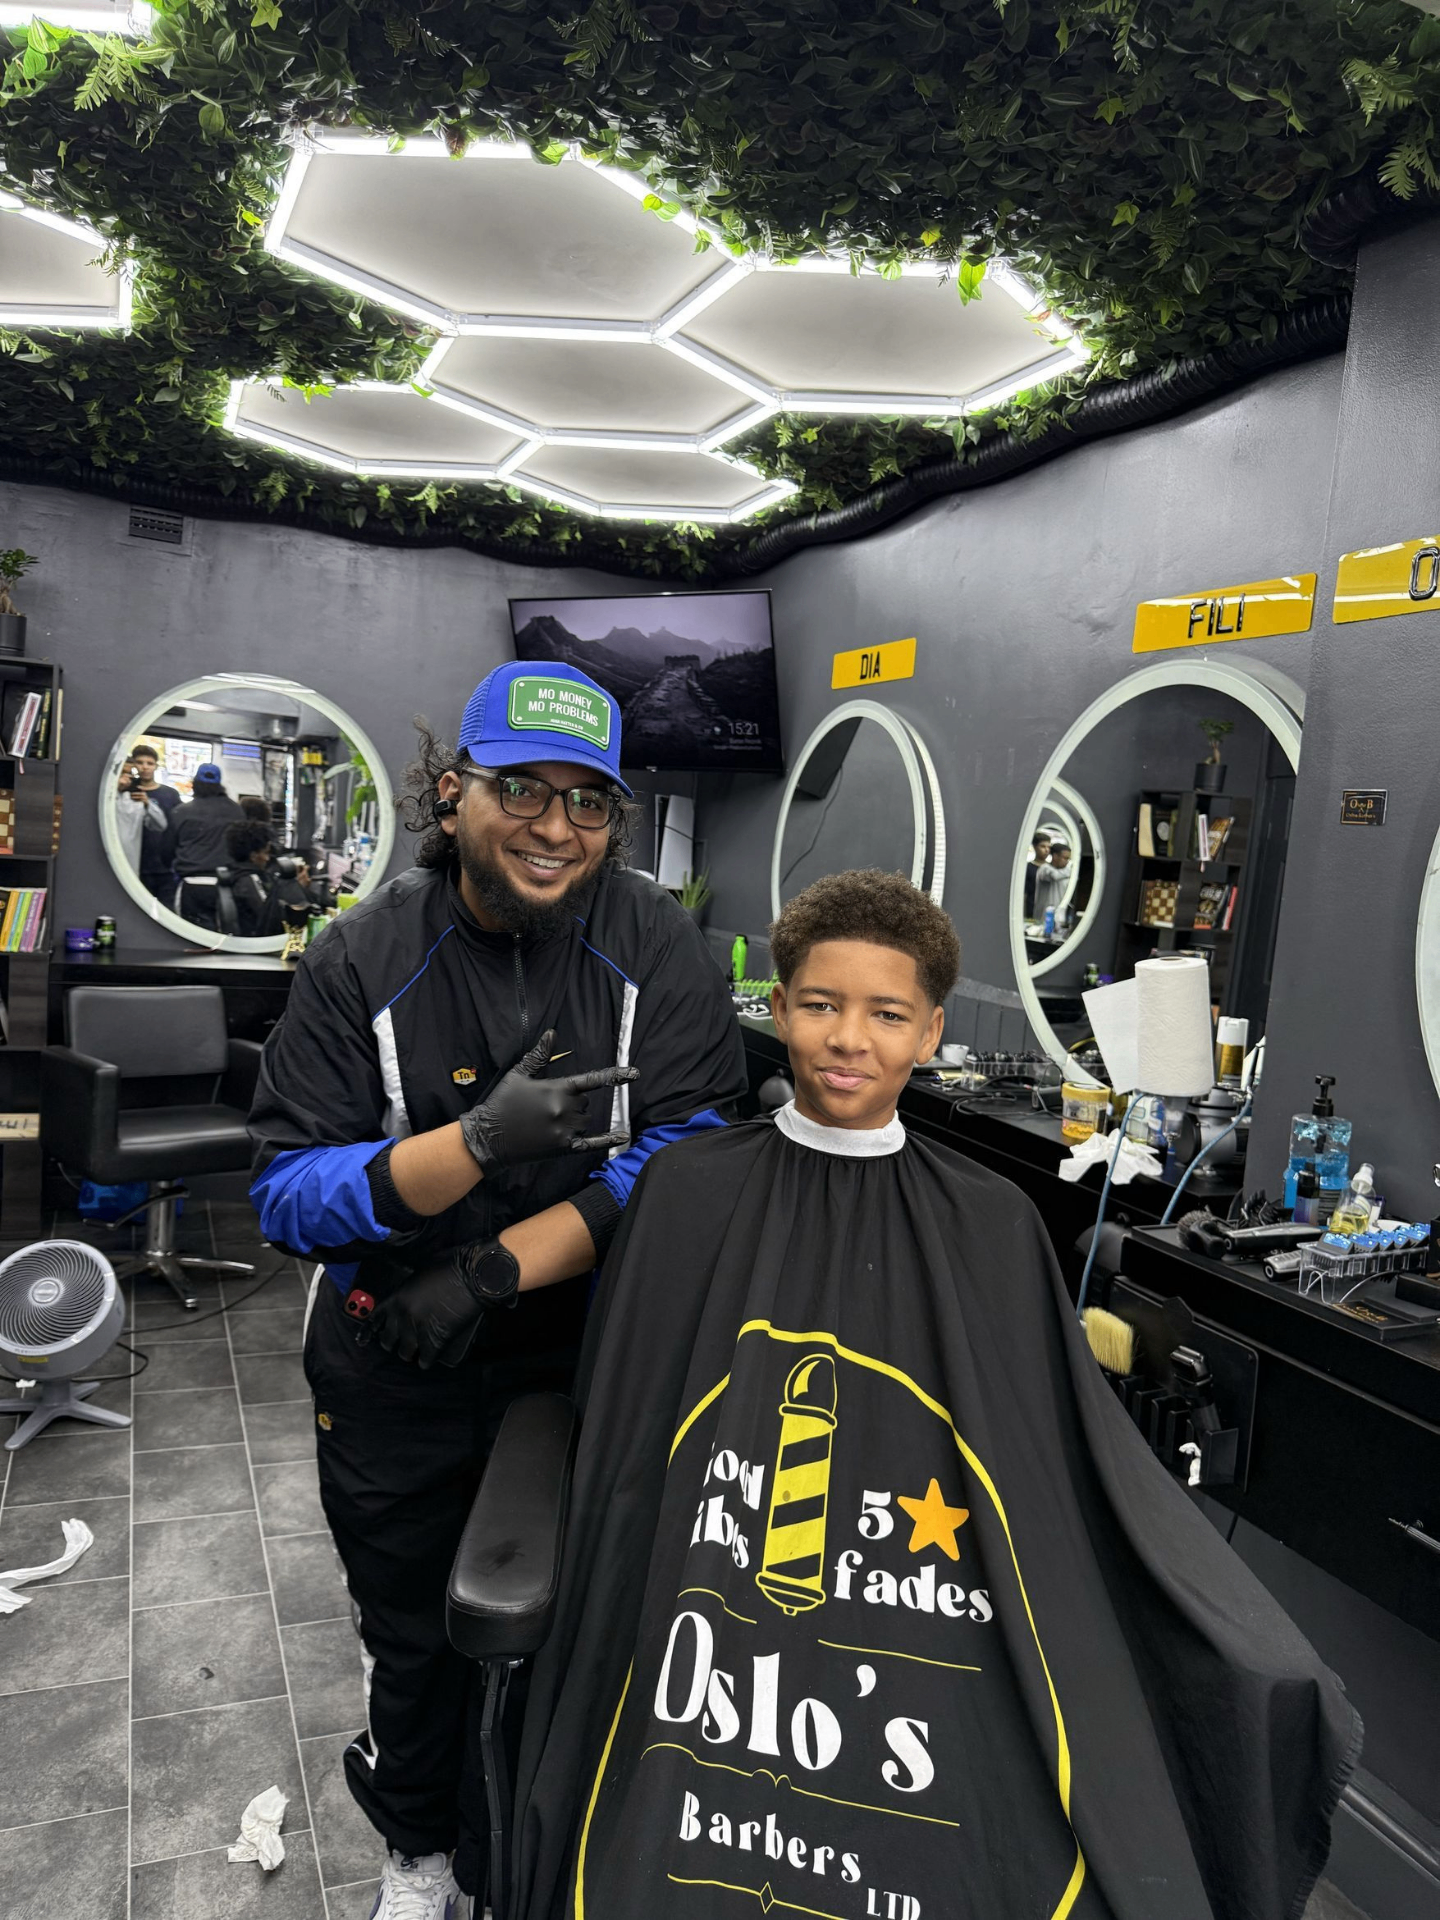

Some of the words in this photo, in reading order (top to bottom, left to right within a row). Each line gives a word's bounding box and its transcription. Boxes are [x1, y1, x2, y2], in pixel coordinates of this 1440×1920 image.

[1409, 546, 1440, 601] O
[1187, 592, 1246, 639] FILI
[860, 650, 881, 680] DIA
[528, 701, 545, 712] MO
[549, 702, 599, 727] PROBLEMS
[538, 688, 555, 700] MO
[559, 690, 592, 710] MONEY
[857, 1489, 895, 1540] 5
[833, 1549, 994, 1623] fades
[654, 1611, 935, 1792] Oslo's
[679, 1790, 862, 1883] Barbers
[866, 1887, 921, 1920] LTD
